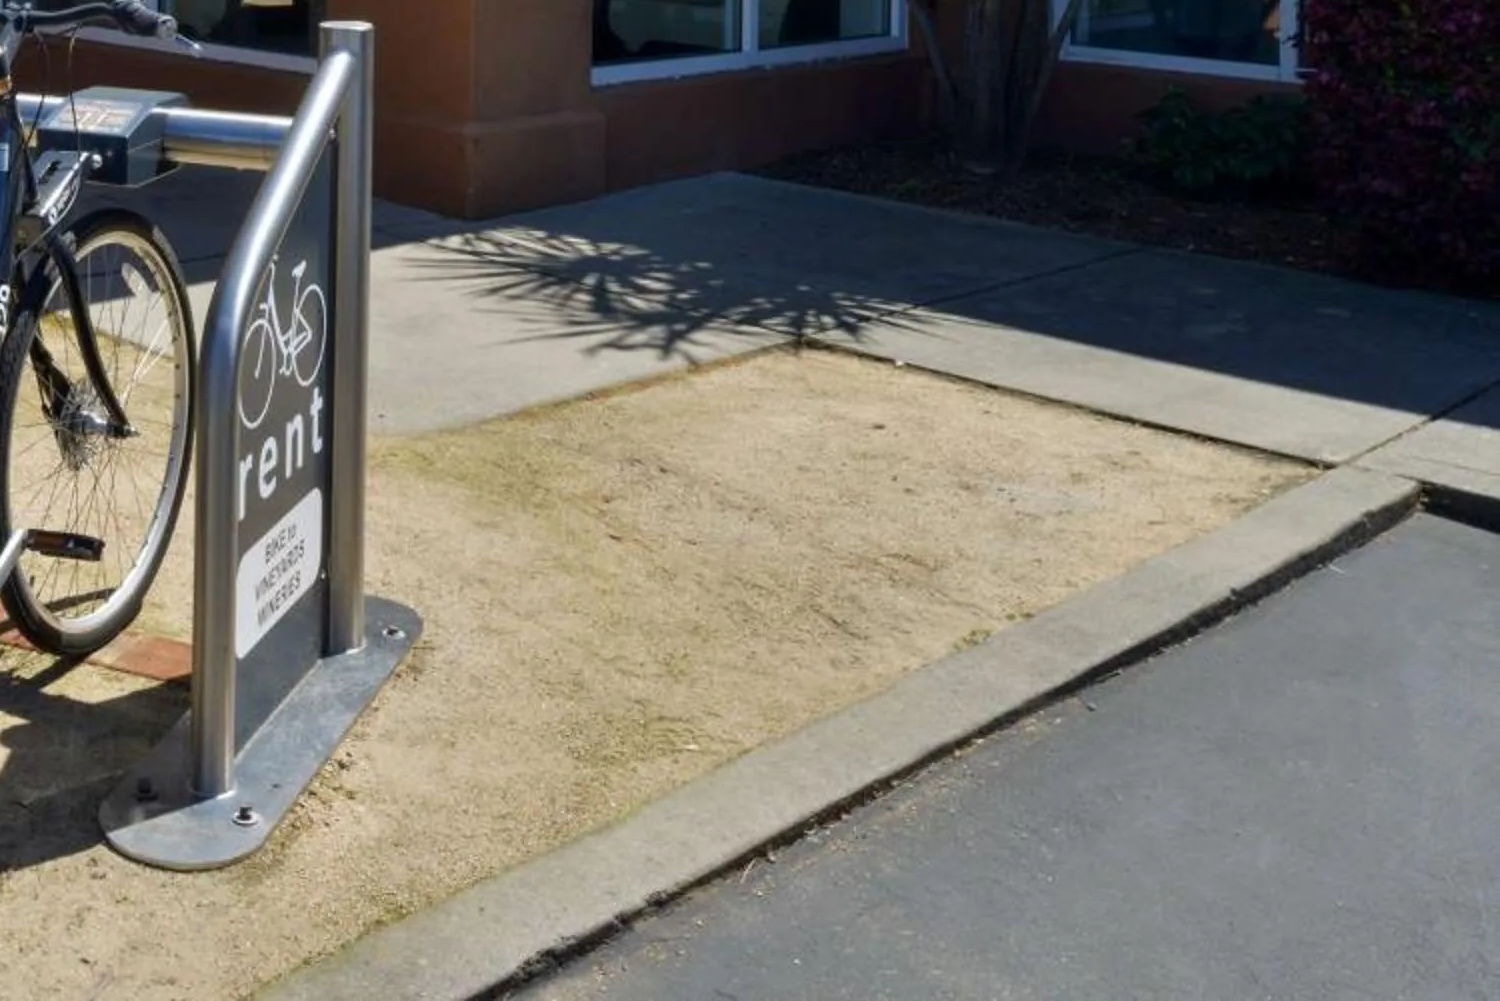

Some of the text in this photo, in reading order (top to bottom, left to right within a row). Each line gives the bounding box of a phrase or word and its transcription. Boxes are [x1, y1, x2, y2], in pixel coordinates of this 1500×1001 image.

[238, 386, 323, 521] rent
[264, 528, 286, 565] BIKE
[257, 570, 301, 627] WINERIES
